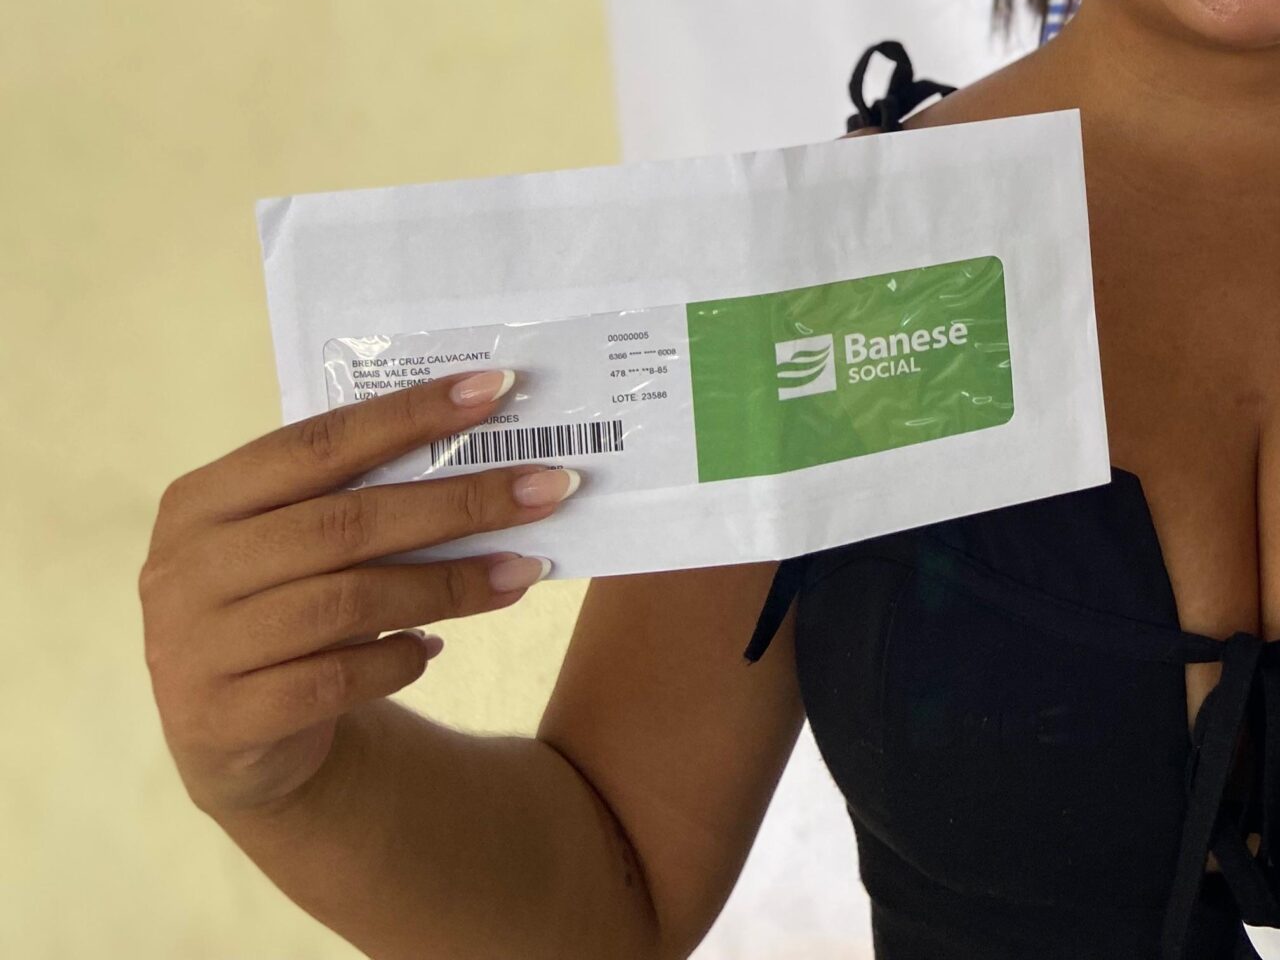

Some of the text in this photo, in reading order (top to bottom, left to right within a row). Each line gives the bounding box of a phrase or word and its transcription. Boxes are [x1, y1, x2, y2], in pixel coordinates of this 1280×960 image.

[608, 332, 649, 342] 00000005
[844, 322, 968, 364] Banese
[352, 359, 388, 368] BRENDA
[399, 356, 425, 366] CRUZ
[427, 351, 490, 364] CALVACANTE
[353, 367, 430, 379] CMAIS VALE GAS
[848, 357, 921, 384] SOCIAL
[354, 380, 392, 389] AVENIDA
[479, 415, 520, 425] OURDES
